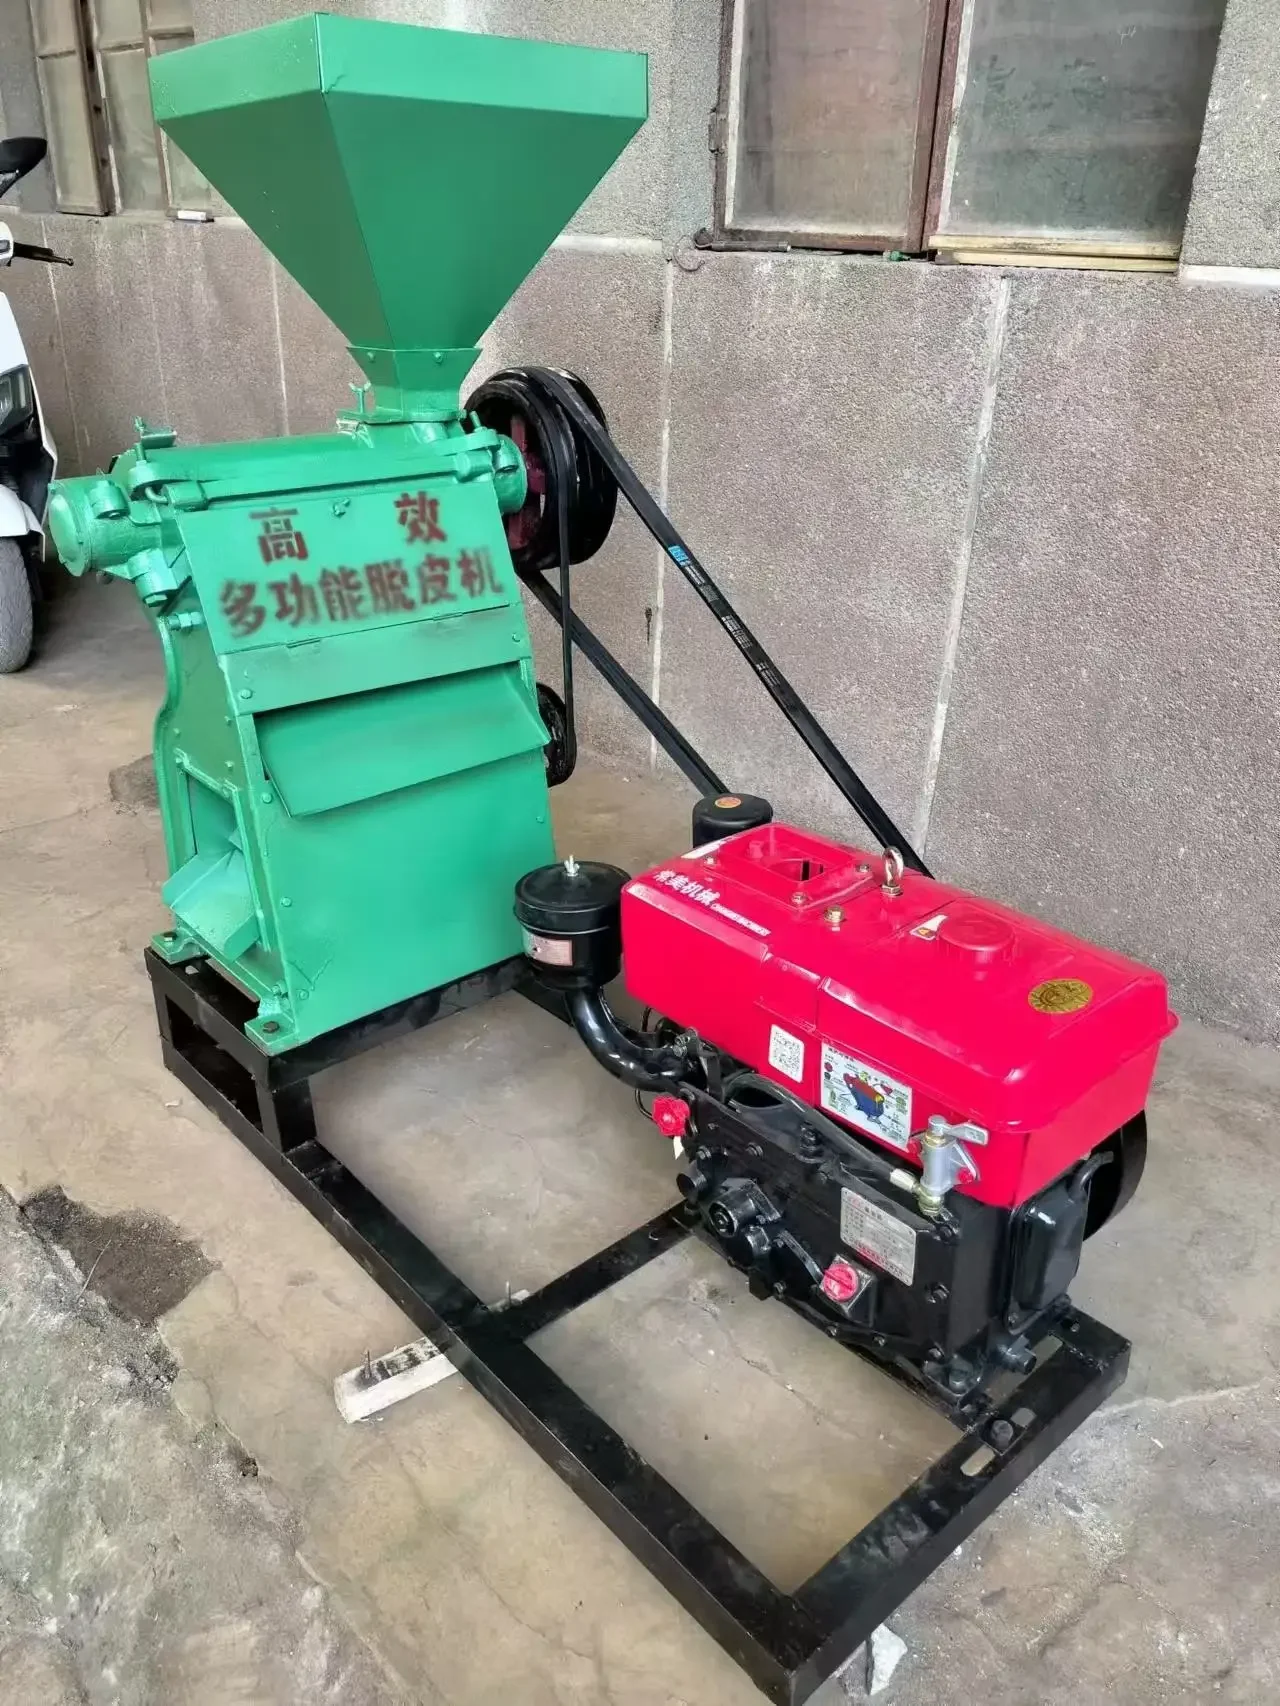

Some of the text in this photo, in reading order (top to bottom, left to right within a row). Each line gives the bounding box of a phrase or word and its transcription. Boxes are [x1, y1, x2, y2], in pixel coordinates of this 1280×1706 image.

[249, 491, 447, 565] 高 效
[220, 546, 504, 638] 多功能脱皮机
